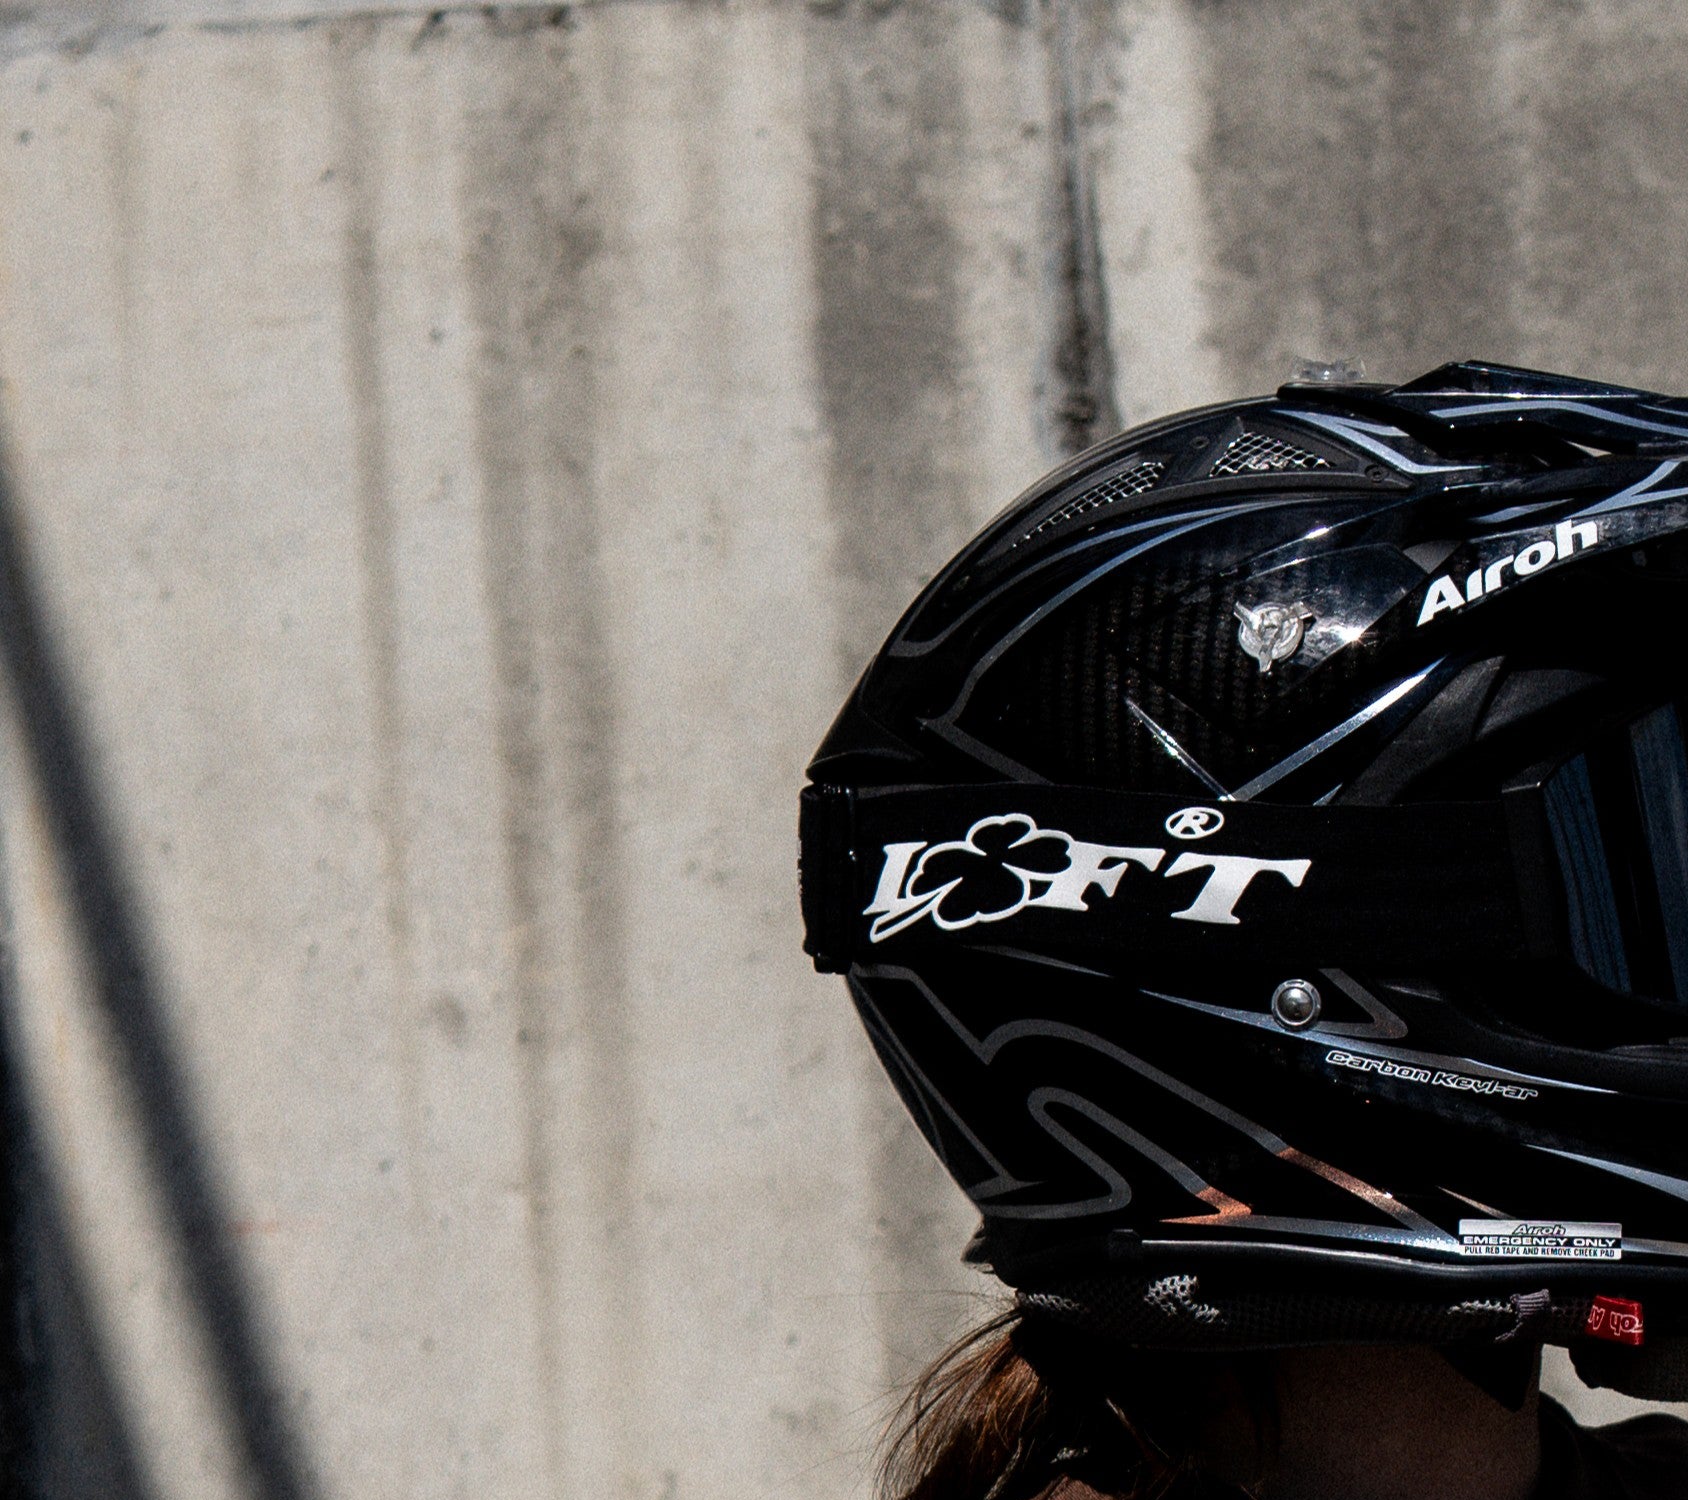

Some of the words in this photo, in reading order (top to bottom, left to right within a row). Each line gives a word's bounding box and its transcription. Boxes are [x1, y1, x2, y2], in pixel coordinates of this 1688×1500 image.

[1416, 519, 1598, 628] Airoh
[1325, 1050, 1431, 1083] Carbon
[1512, 1224, 1567, 1236] Airoh
[1463, 1235, 1567, 1246] EMERGENCY
[1573, 1237, 1616, 1248] ONLY
[1464, 1246, 1482, 1254] PULL
[1485, 1246, 1500, 1254] RED
[1502, 1246, 1520, 1255] TAPE
[1523, 1247, 1539, 1255] AND
[1541, 1247, 1571, 1256] REMOVE
[1574, 1248, 1598, 1257] CHEEK
[1600, 1248, 1615, 1257] PAD
